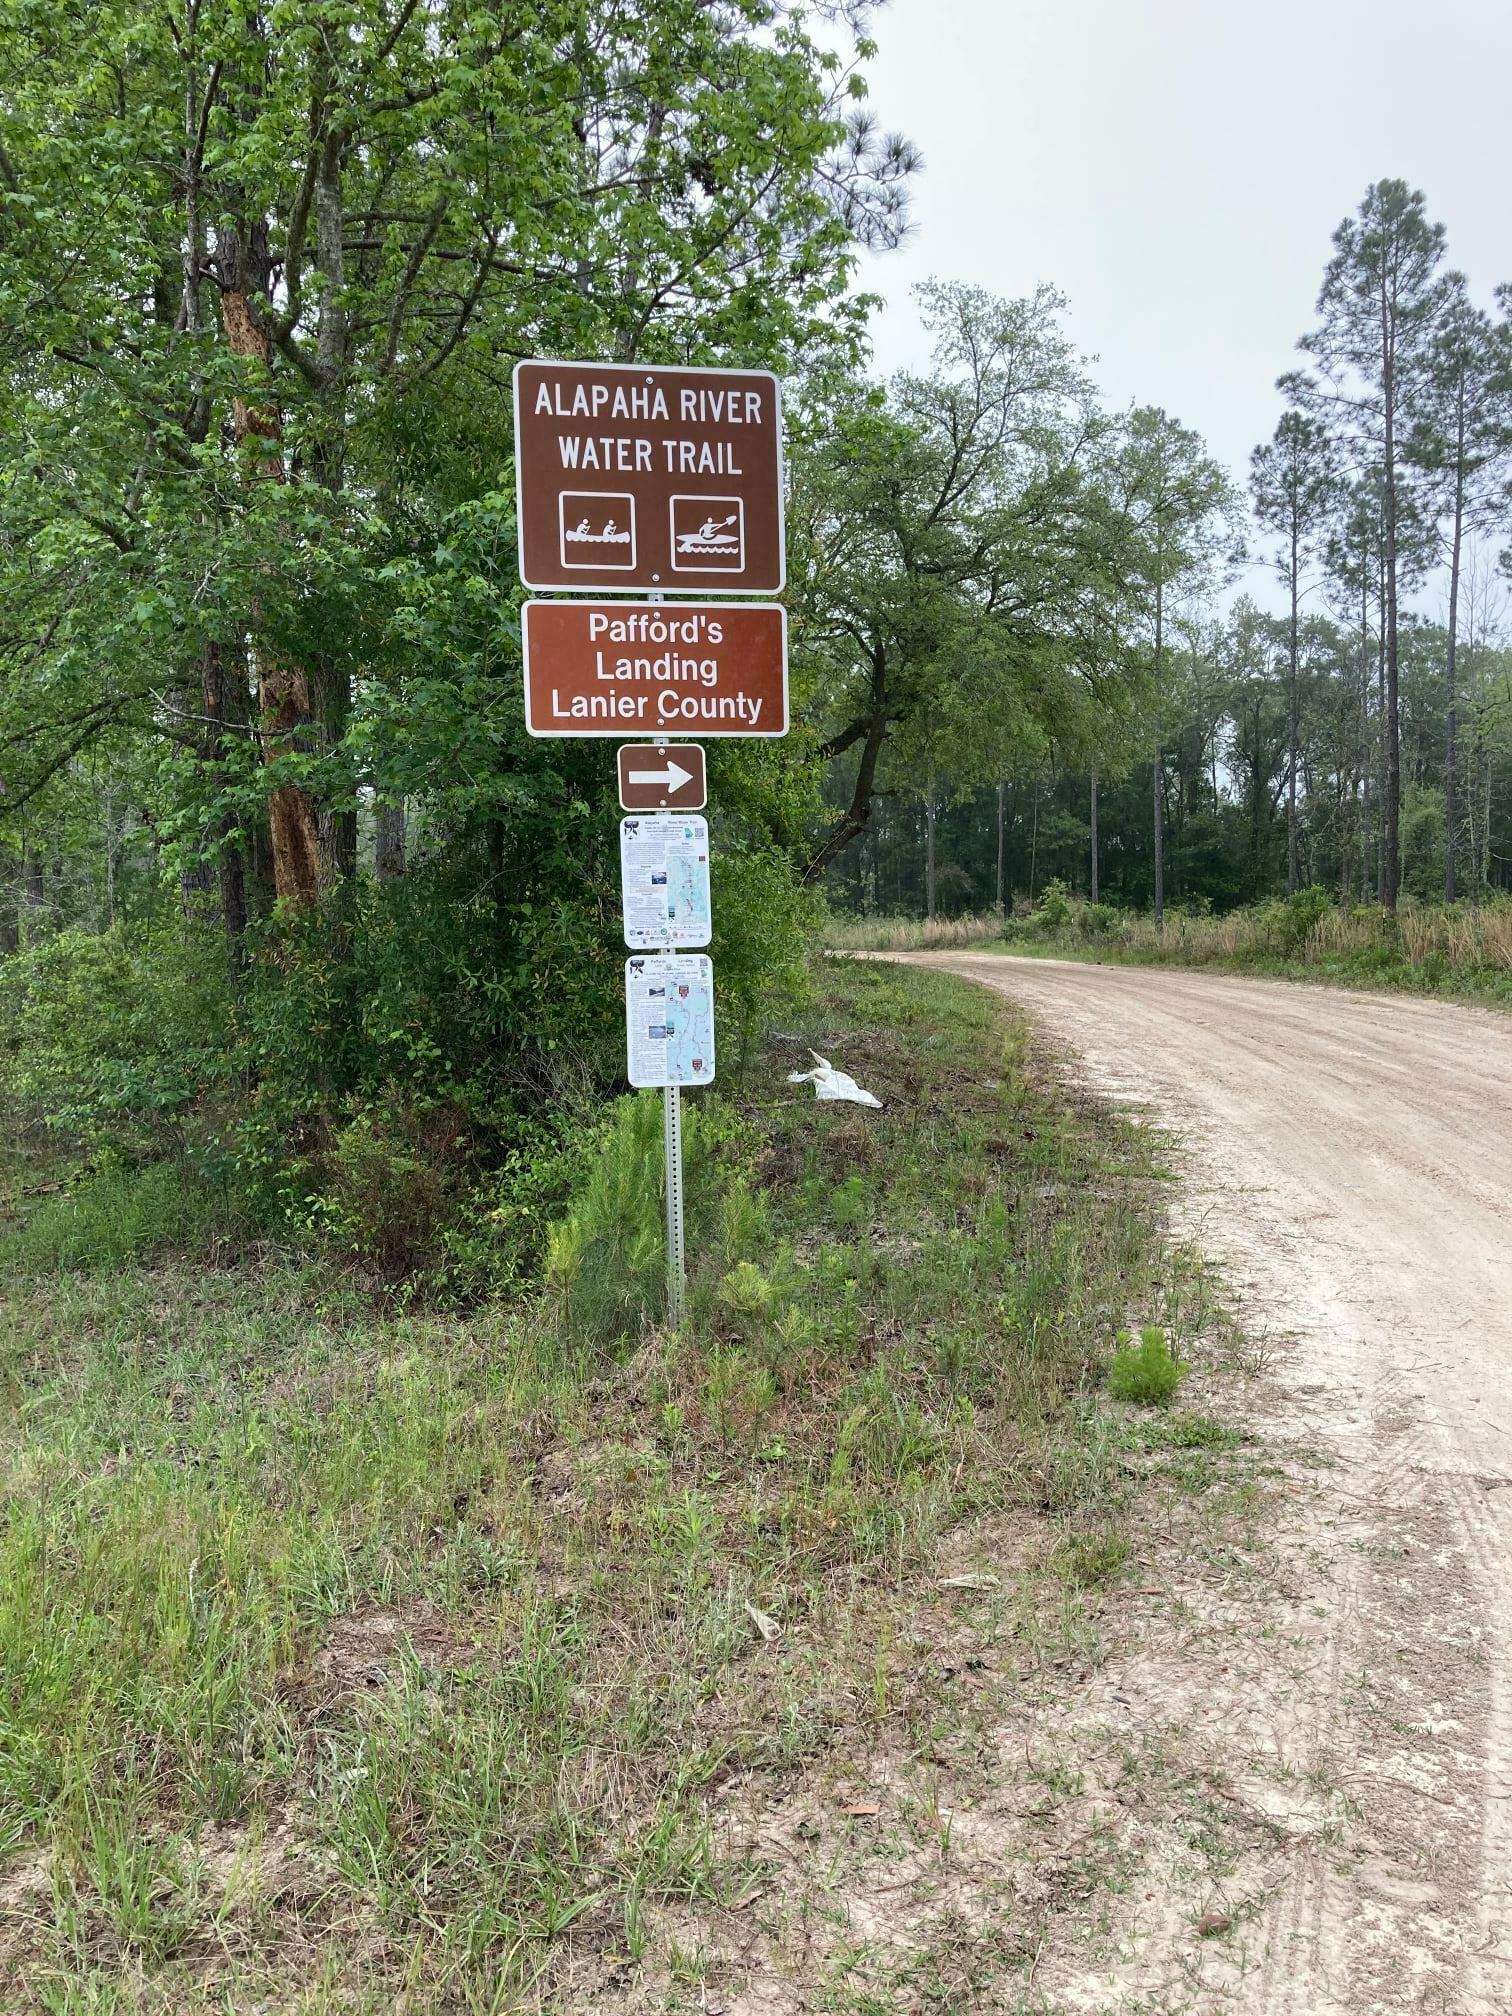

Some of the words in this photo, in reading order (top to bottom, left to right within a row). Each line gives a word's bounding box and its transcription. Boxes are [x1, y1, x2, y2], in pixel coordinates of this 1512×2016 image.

[535, 382, 669, 420] ALAPAHA
[681, 390, 762, 424] RIVER
[558, 436, 652, 471] WATER
[662, 441, 742, 475] TRAIL
[590, 613, 723, 644] Pafford's
[596, 651, 718, 686] Landing
[552, 689, 648, 718] Lanier
[657, 689, 763, 725] County
